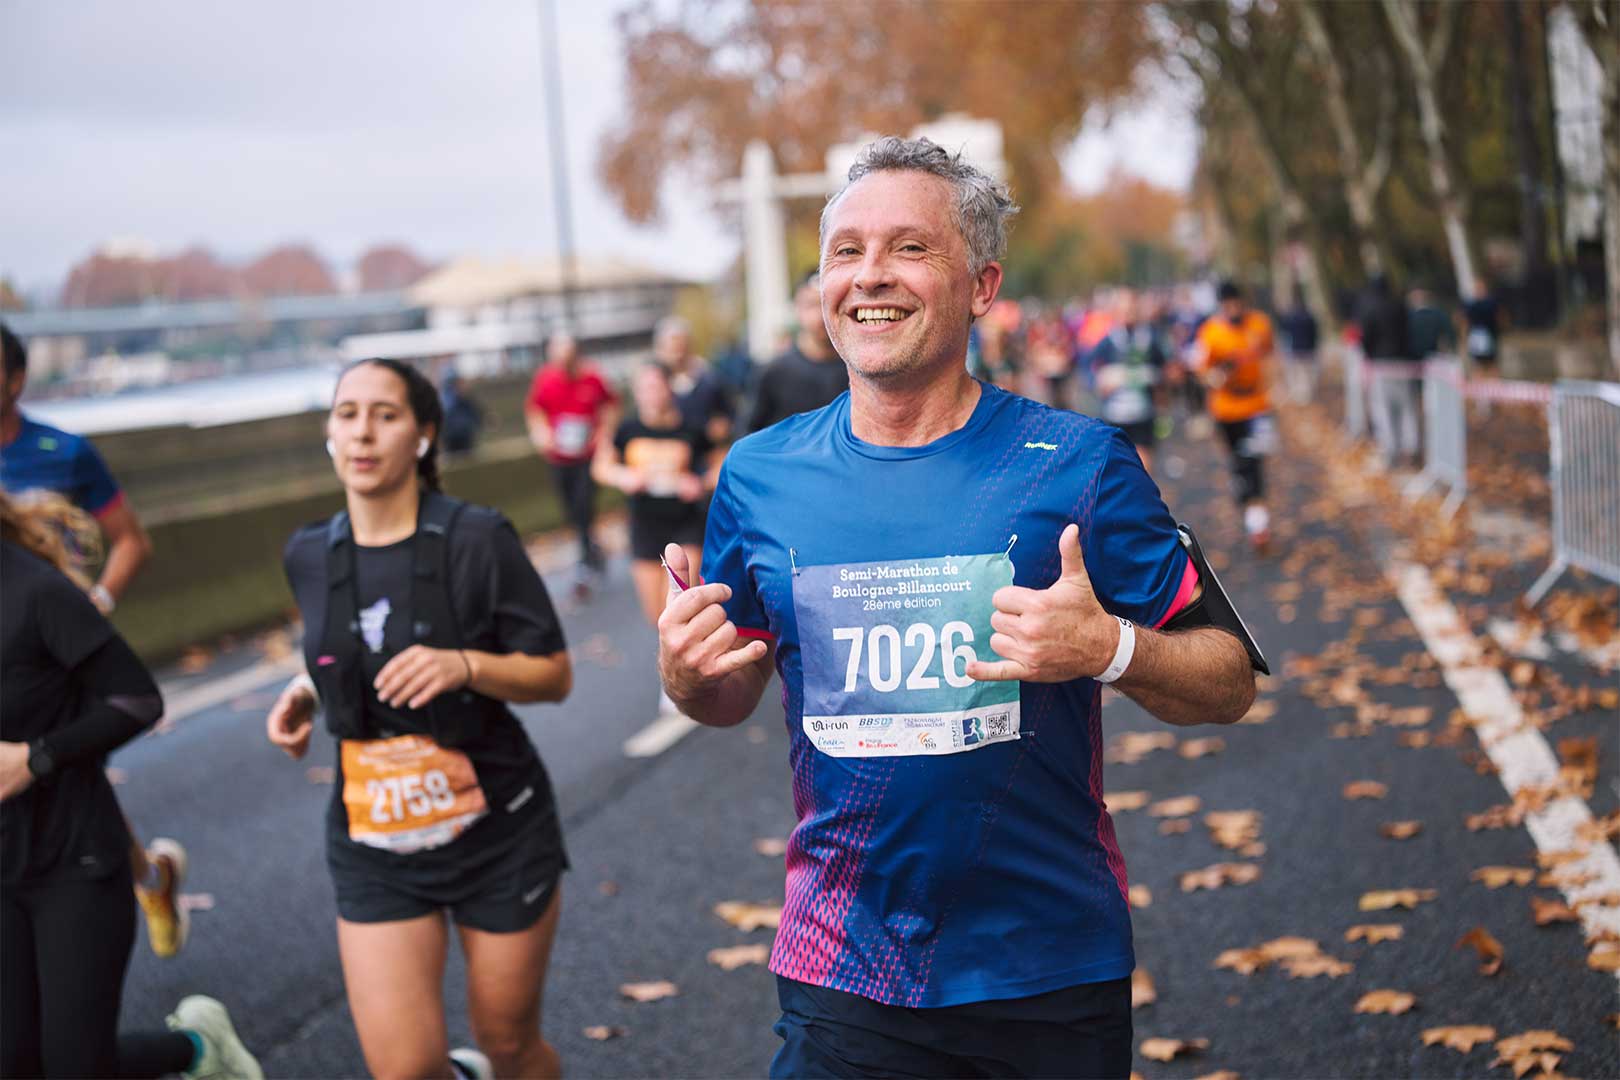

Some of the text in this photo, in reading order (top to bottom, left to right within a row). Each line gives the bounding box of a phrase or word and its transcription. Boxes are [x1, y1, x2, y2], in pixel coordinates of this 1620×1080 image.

[840, 562, 958, 582] Semi-Marathon de
[832, 580, 972, 599] Boulogne-Billancourt
[863, 596, 942, 612] 28ème édition
[832, 621, 978, 692] 7026
[825, 719, 849, 730] i-run
[366, 768, 455, 823] 2758
